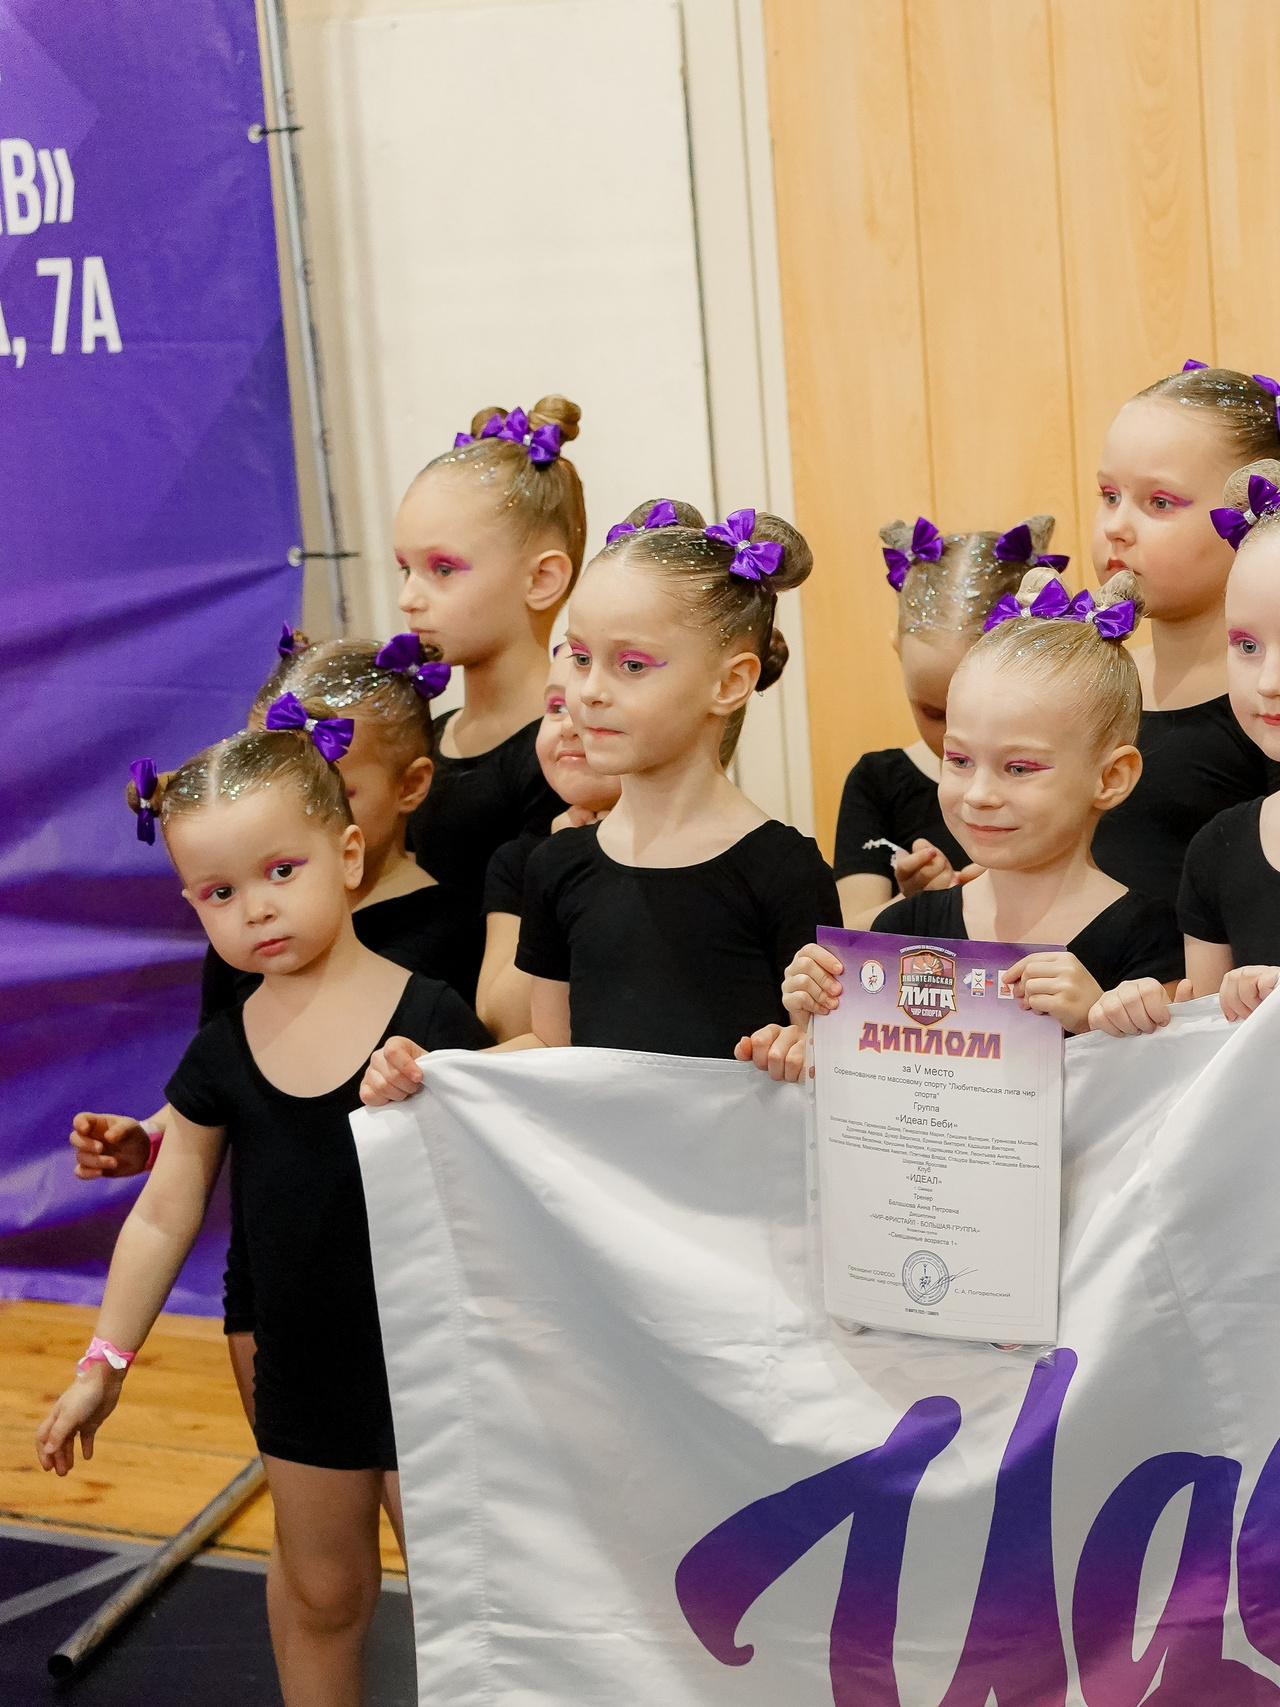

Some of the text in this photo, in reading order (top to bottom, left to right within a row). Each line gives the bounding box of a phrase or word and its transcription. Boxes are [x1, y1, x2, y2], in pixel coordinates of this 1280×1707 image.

[0, 138, 75, 235] В»
[36, 256, 122, 355] 7А
[902, 975, 953, 986] ЛЮБИТЕЛЬСКАЯ
[899, 986, 956, 1011] ЛИГА
[922, 1009, 943, 1018] СПОРТА
[859, 1022, 1001, 1060] ДИПЛОМ
[834, 1066, 877, 1080] Соревнование
[887, 1077, 923, 1088] массовому
[924, 1081, 947, 1090] спорту
[902, 1063, 954, 1078] за V место
[913, 1102, 940, 1113] Группа
[895, 1114, 958, 1129] «Идеал Беби»
[917, 1165, 932, 1174] Клуб
[905, 1173, 943, 1185] «ИДЕАЛ»
[913, 1193, 934, 1202] Тренер
[888, 1198, 960, 1215] Балашова Анна Петровна
[924, 1236, 950, 1246] возраста
